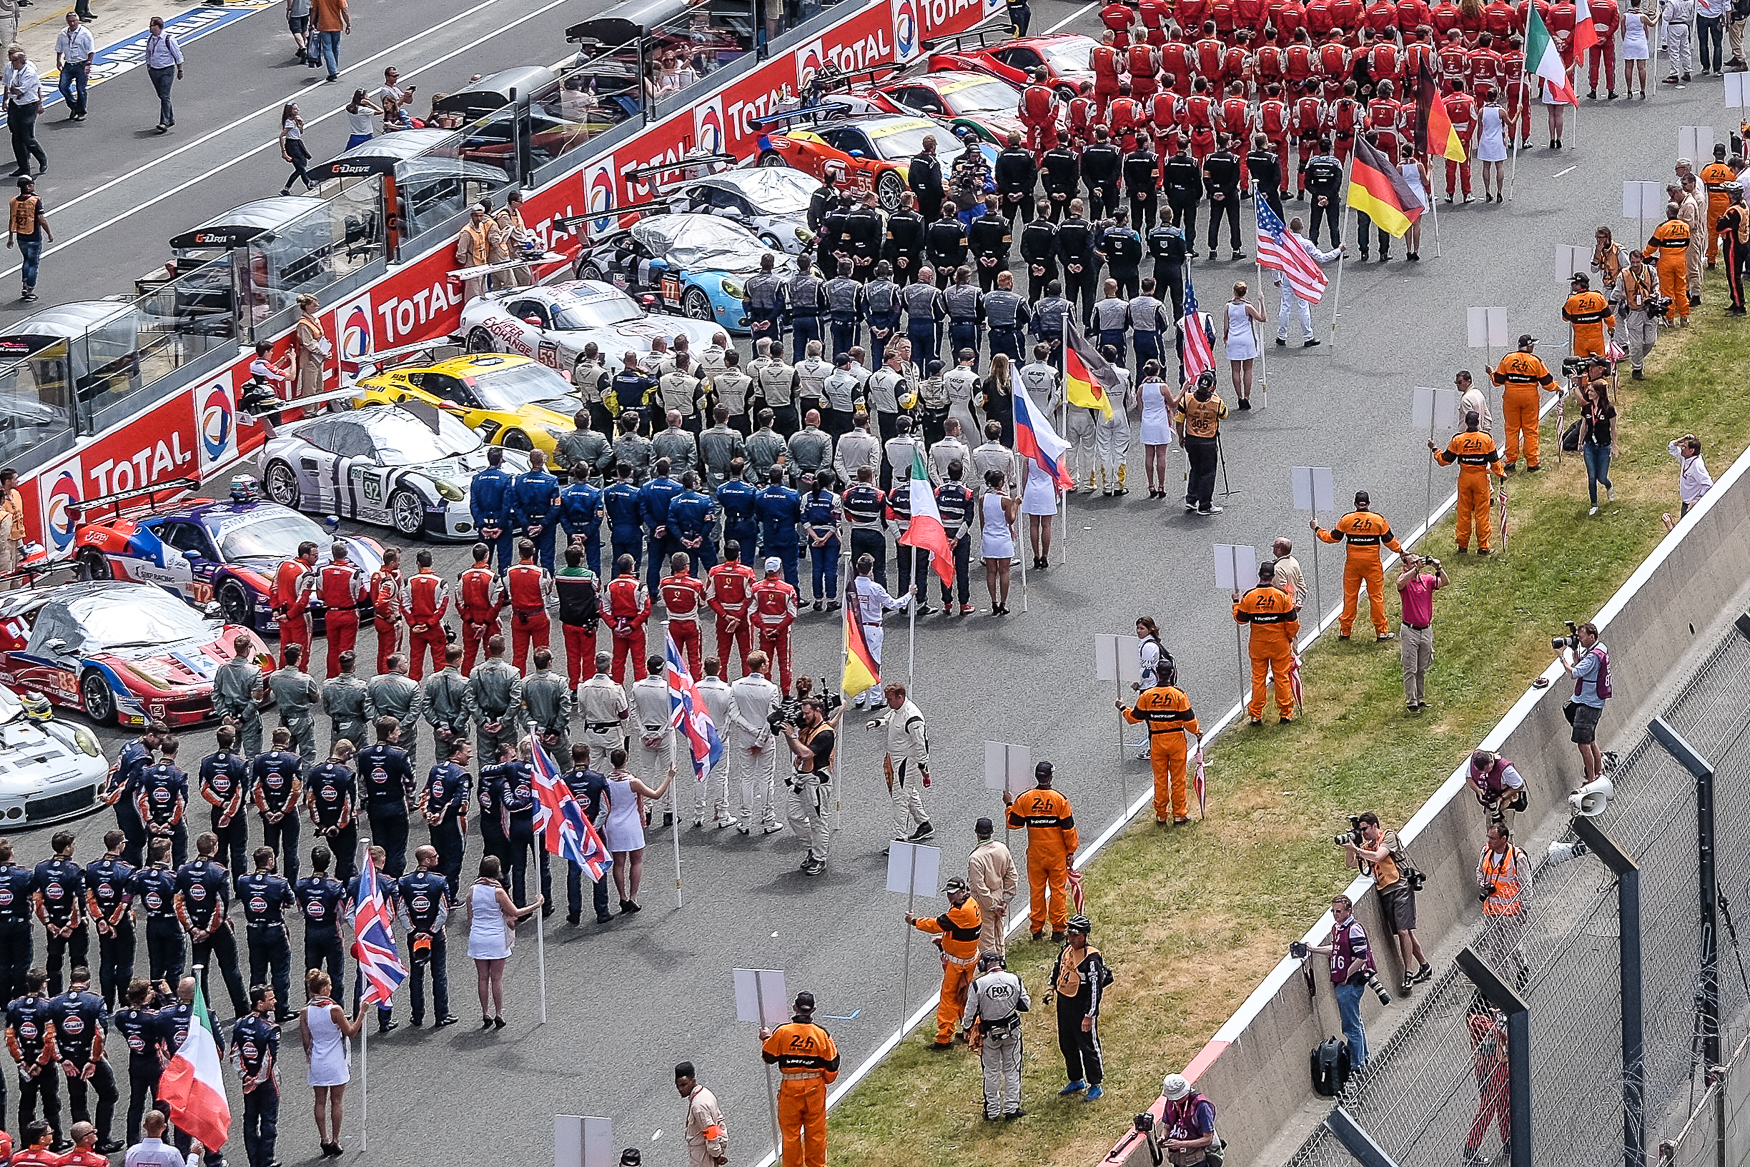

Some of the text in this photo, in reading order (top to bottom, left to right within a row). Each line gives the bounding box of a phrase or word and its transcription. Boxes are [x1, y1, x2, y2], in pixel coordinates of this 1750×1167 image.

[824, 29, 890, 78] TOTAL
[377, 282, 462, 343] TOTAL
[538, 347, 557, 367] 53
[90, 431, 192, 512] TOTAL
[365, 480, 382, 502] 92
[58, 672, 77, 692] 83
[1032, 798, 1054, 810] 24h
[992, 985, 1014, 999] FOX
[790, 1035, 814, 1048] 24h
